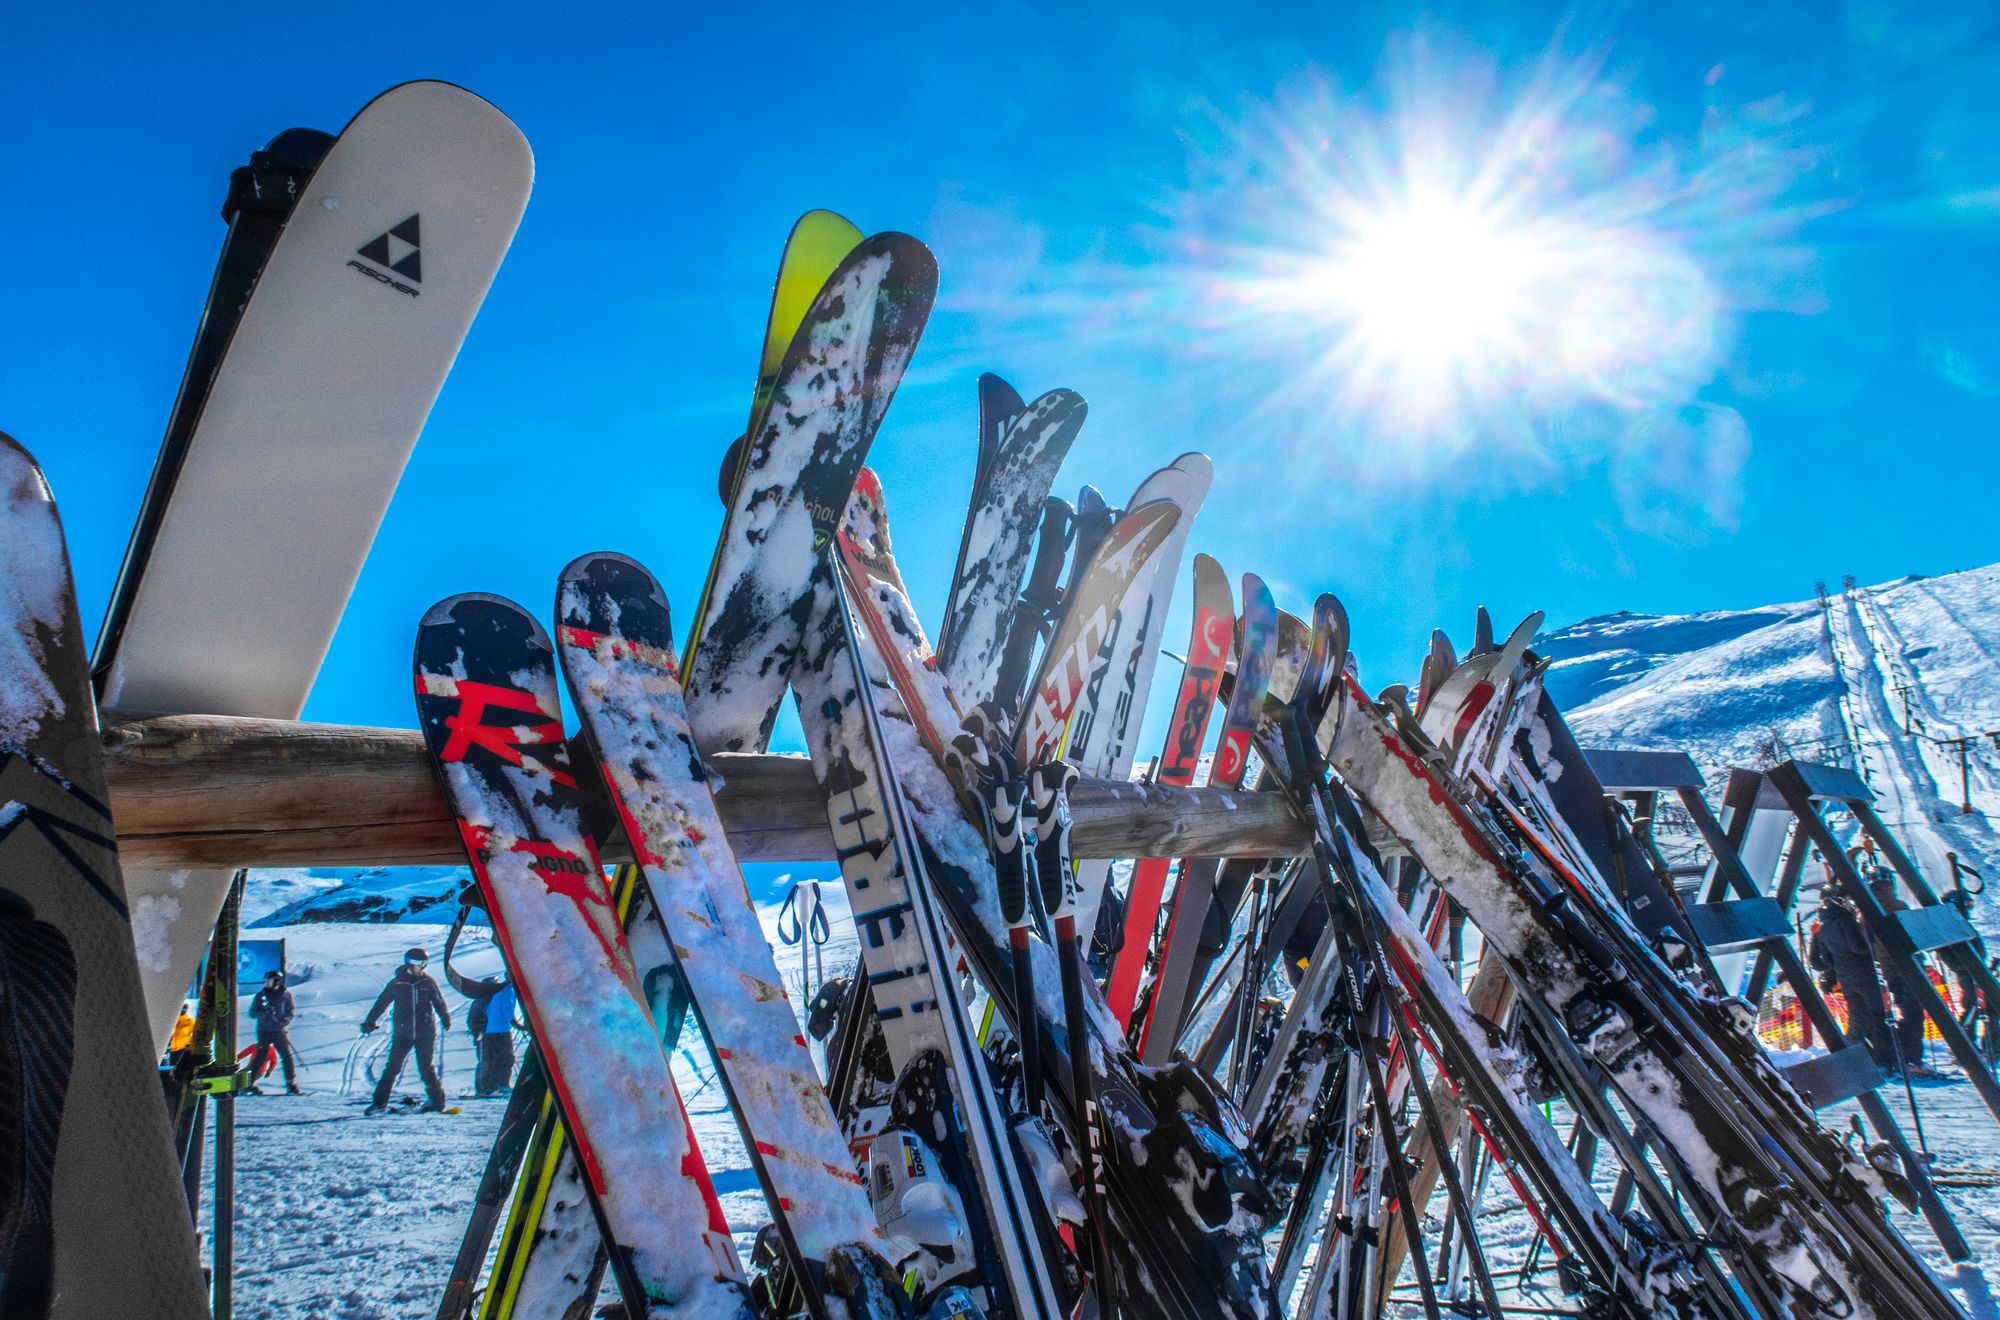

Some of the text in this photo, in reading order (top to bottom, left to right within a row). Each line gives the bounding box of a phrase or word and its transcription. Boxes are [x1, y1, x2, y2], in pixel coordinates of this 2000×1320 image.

[346, 260, 420, 298] FISCHER
[1162, 666, 1218, 777] head
[1061, 855, 1076, 906] LEKI
[1375, 940, 1393, 985] ATOMIC
[1346, 964, 1363, 1012] ATOMIC
[911, 1145, 926, 1178] LOOK
